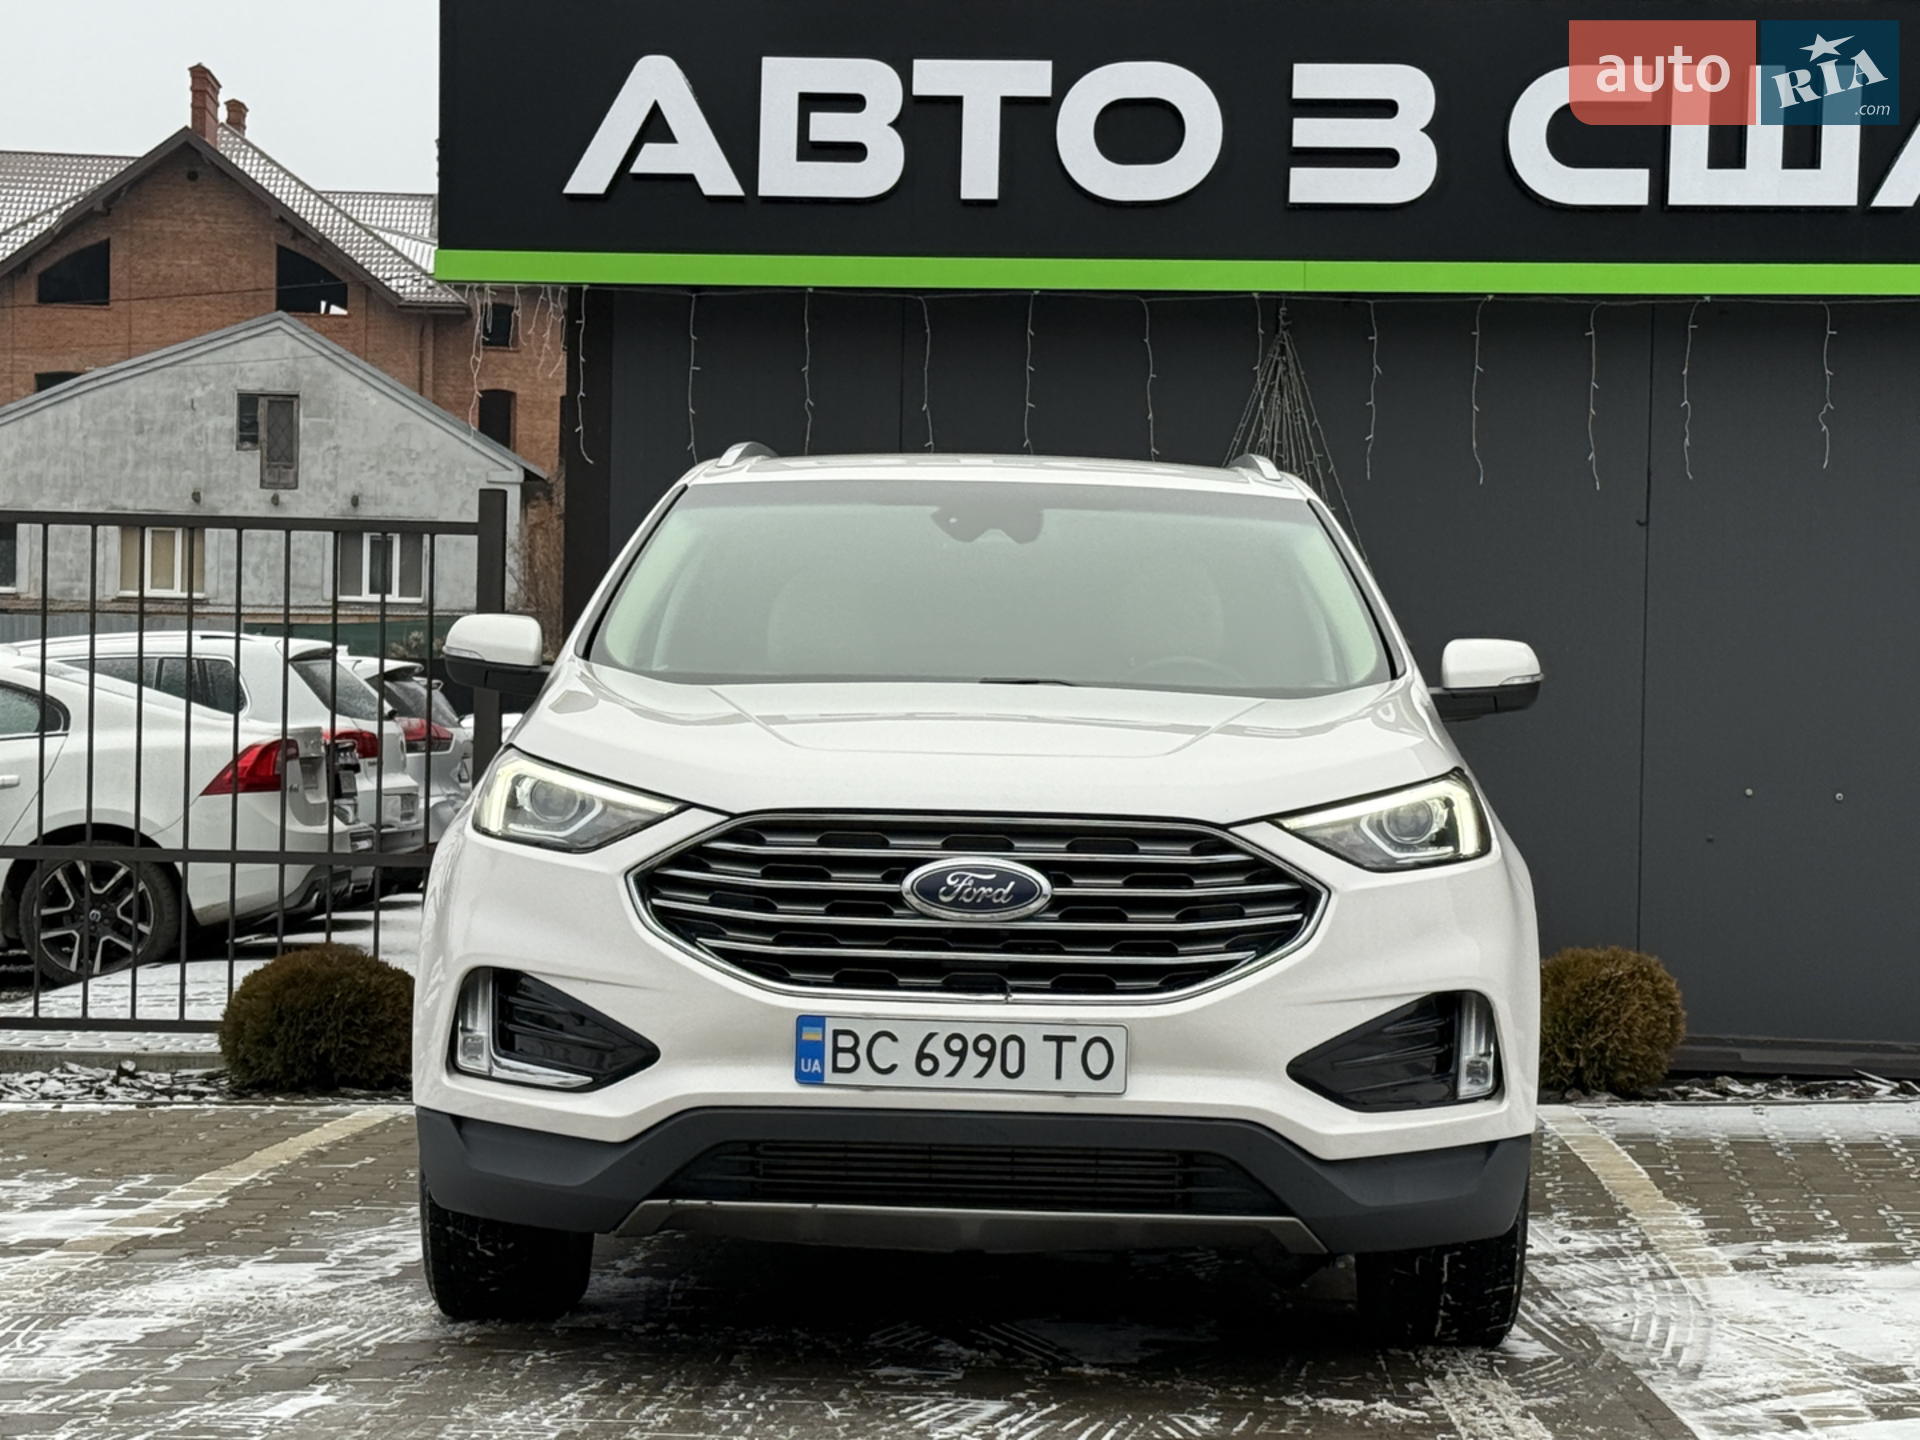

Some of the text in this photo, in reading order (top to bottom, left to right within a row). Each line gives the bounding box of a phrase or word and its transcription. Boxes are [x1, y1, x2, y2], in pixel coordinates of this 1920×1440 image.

[562, 54, 1920, 207] АВТО З СШ
[938, 871, 1015, 903] Ford
[801, 1058, 822, 1074] UA
[832, 1029, 1115, 1081] BC 6990 TO
